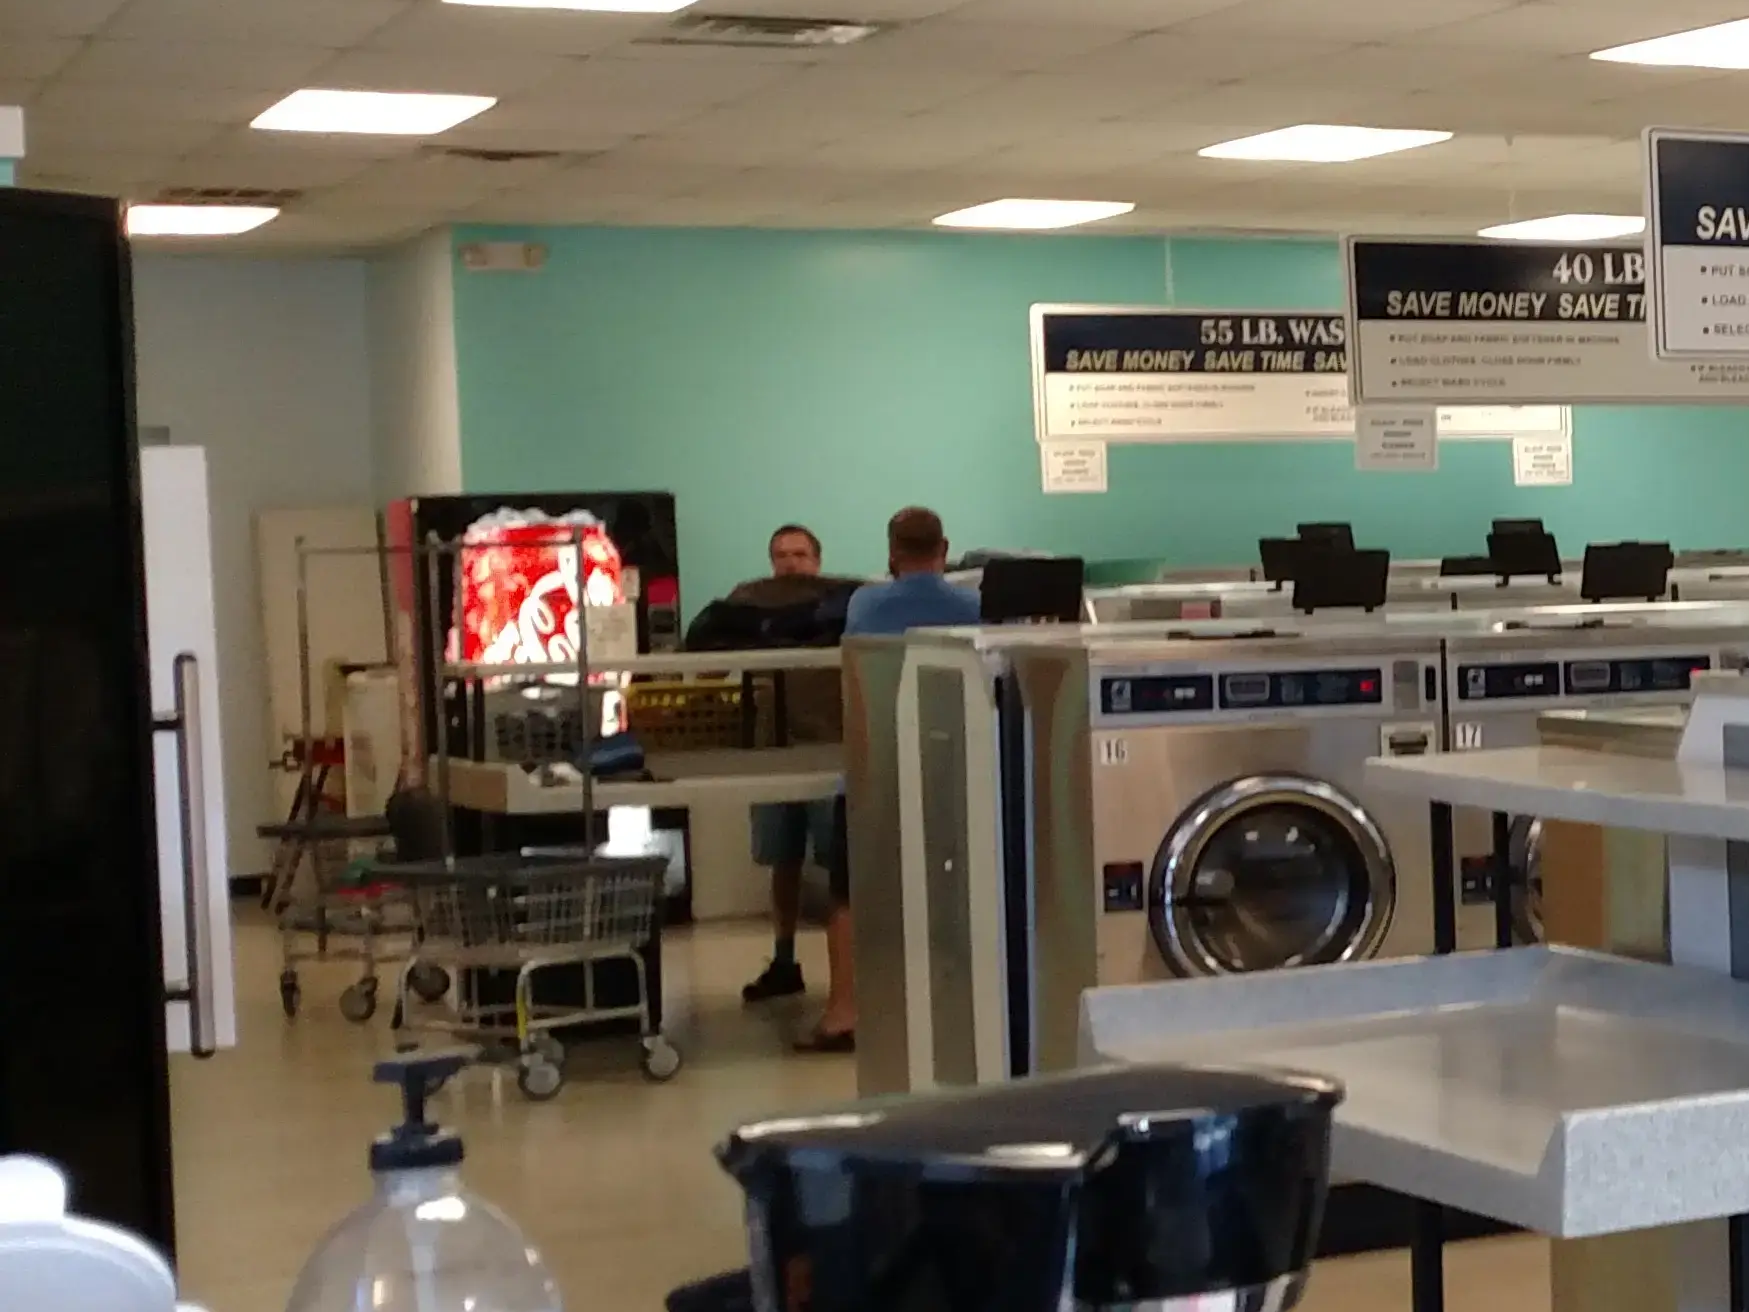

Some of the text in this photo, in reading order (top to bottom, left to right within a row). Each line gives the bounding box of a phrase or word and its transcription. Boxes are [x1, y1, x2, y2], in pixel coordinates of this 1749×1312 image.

[1552, 251, 1594, 285] 40
[1711, 265, 1734, 278] PUT
[1387, 290, 1452, 318] SAVE
[1457, 291, 1547, 318] MONEY
[1558, 293, 1620, 319] SAVE
[1711, 295, 1746, 307] LOAD
[1200, 319, 1233, 346] 55
[1241, 319, 1284, 345] LB.
[1066, 349, 1119, 372] SAVE
[1123, 349, 1195, 372] MONEY
[1204, 349, 1255, 372] SAVE
[1261, 350, 1306, 372] TIME
[1461, 723, 1479, 748] 17
[1105, 740, 1126, 760] 16
